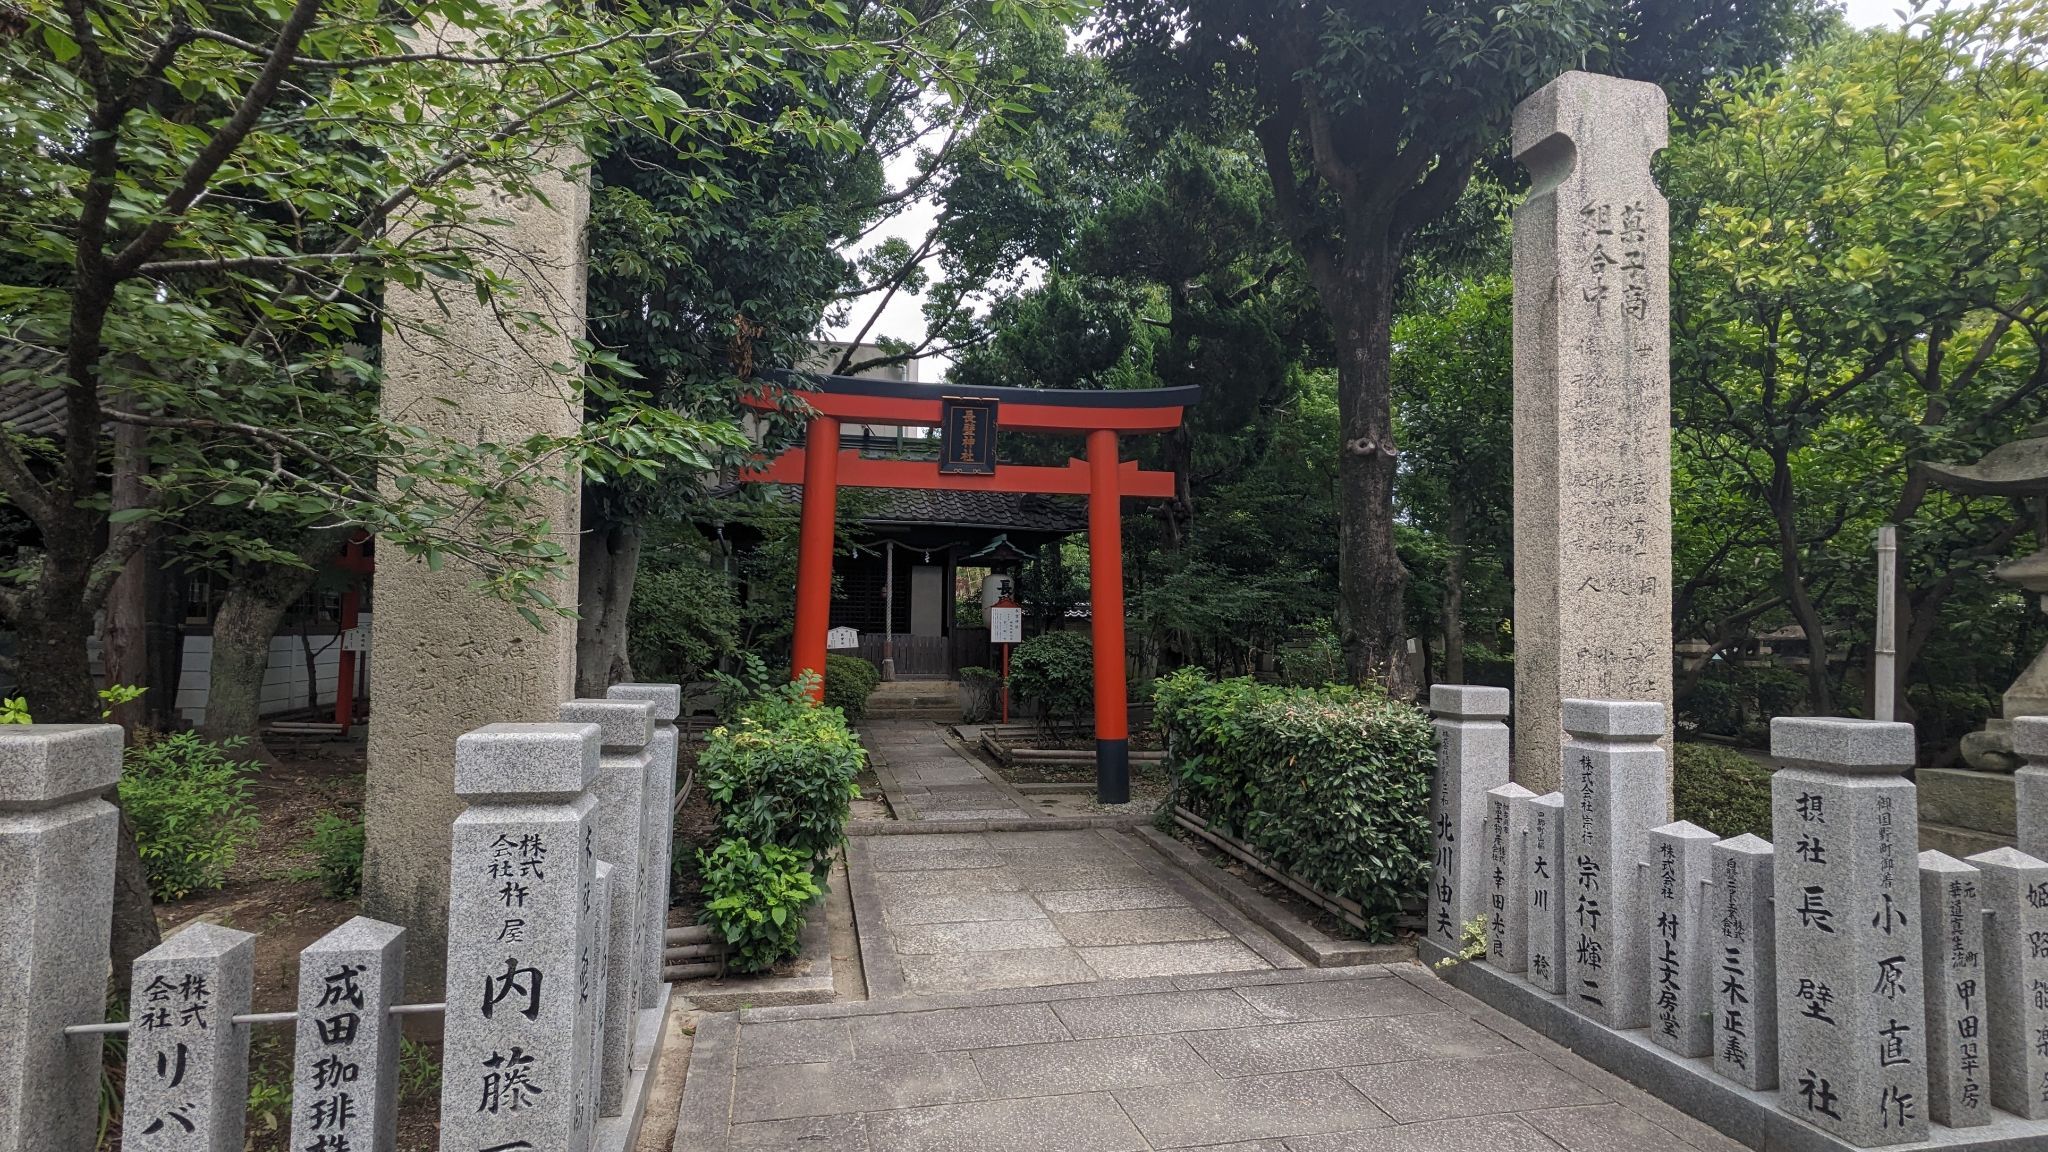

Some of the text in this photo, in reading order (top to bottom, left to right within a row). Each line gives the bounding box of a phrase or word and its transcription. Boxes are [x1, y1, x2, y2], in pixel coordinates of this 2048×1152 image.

[961, 409, 976, 464] 長壁神社
[1436, 812, 1454, 940] 北川由夫
[1576, 855, 1603, 1007] 宗行輝二
[1660, 842, 1676, 899] 株式会社
[475, 957, 544, 1152] 内藤
[1721, 947, 1749, 1070] 三木正義
[1872, 893, 1915, 1129] 小原直作
